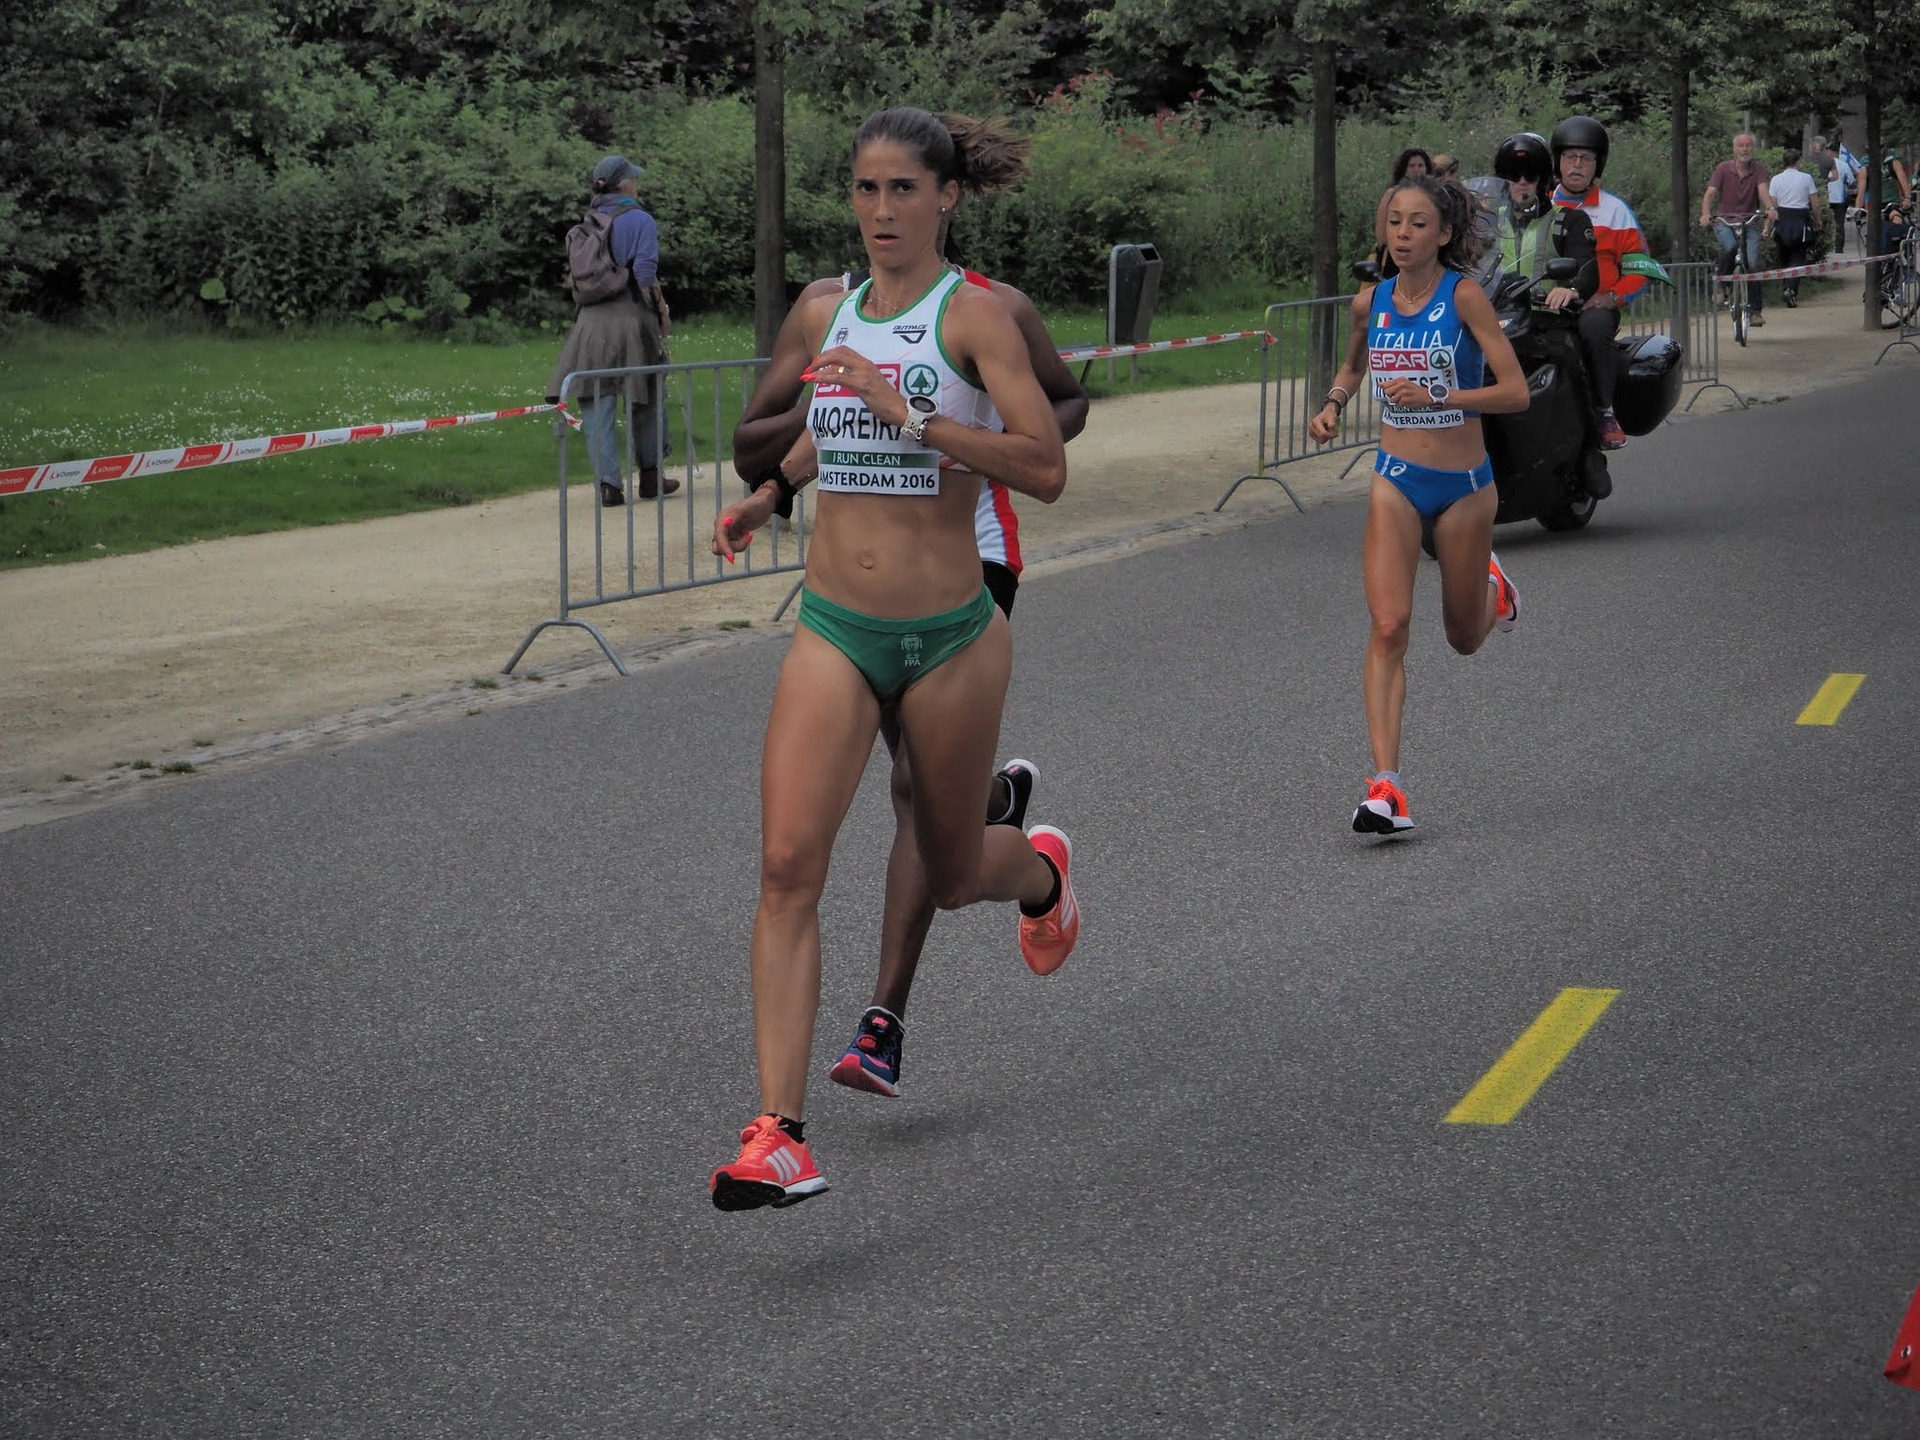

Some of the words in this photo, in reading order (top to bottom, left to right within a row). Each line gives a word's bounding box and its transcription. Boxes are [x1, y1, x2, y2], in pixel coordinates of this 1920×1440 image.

[1375, 330, 1442, 348] ITALIA
[1371, 353, 1427, 368] SPAR
[812, 406, 902, 441] MOREIR
[1438, 412, 1461, 424] 2016
[832, 452, 836, 463] I
[836, 452, 859, 465] RUN
[862, 454, 901, 466] CLEAN
[819, 470, 895, 488] AMSTERDAM
[900, 474, 935, 489] 2016
[904, 659, 921, 667] FPA
